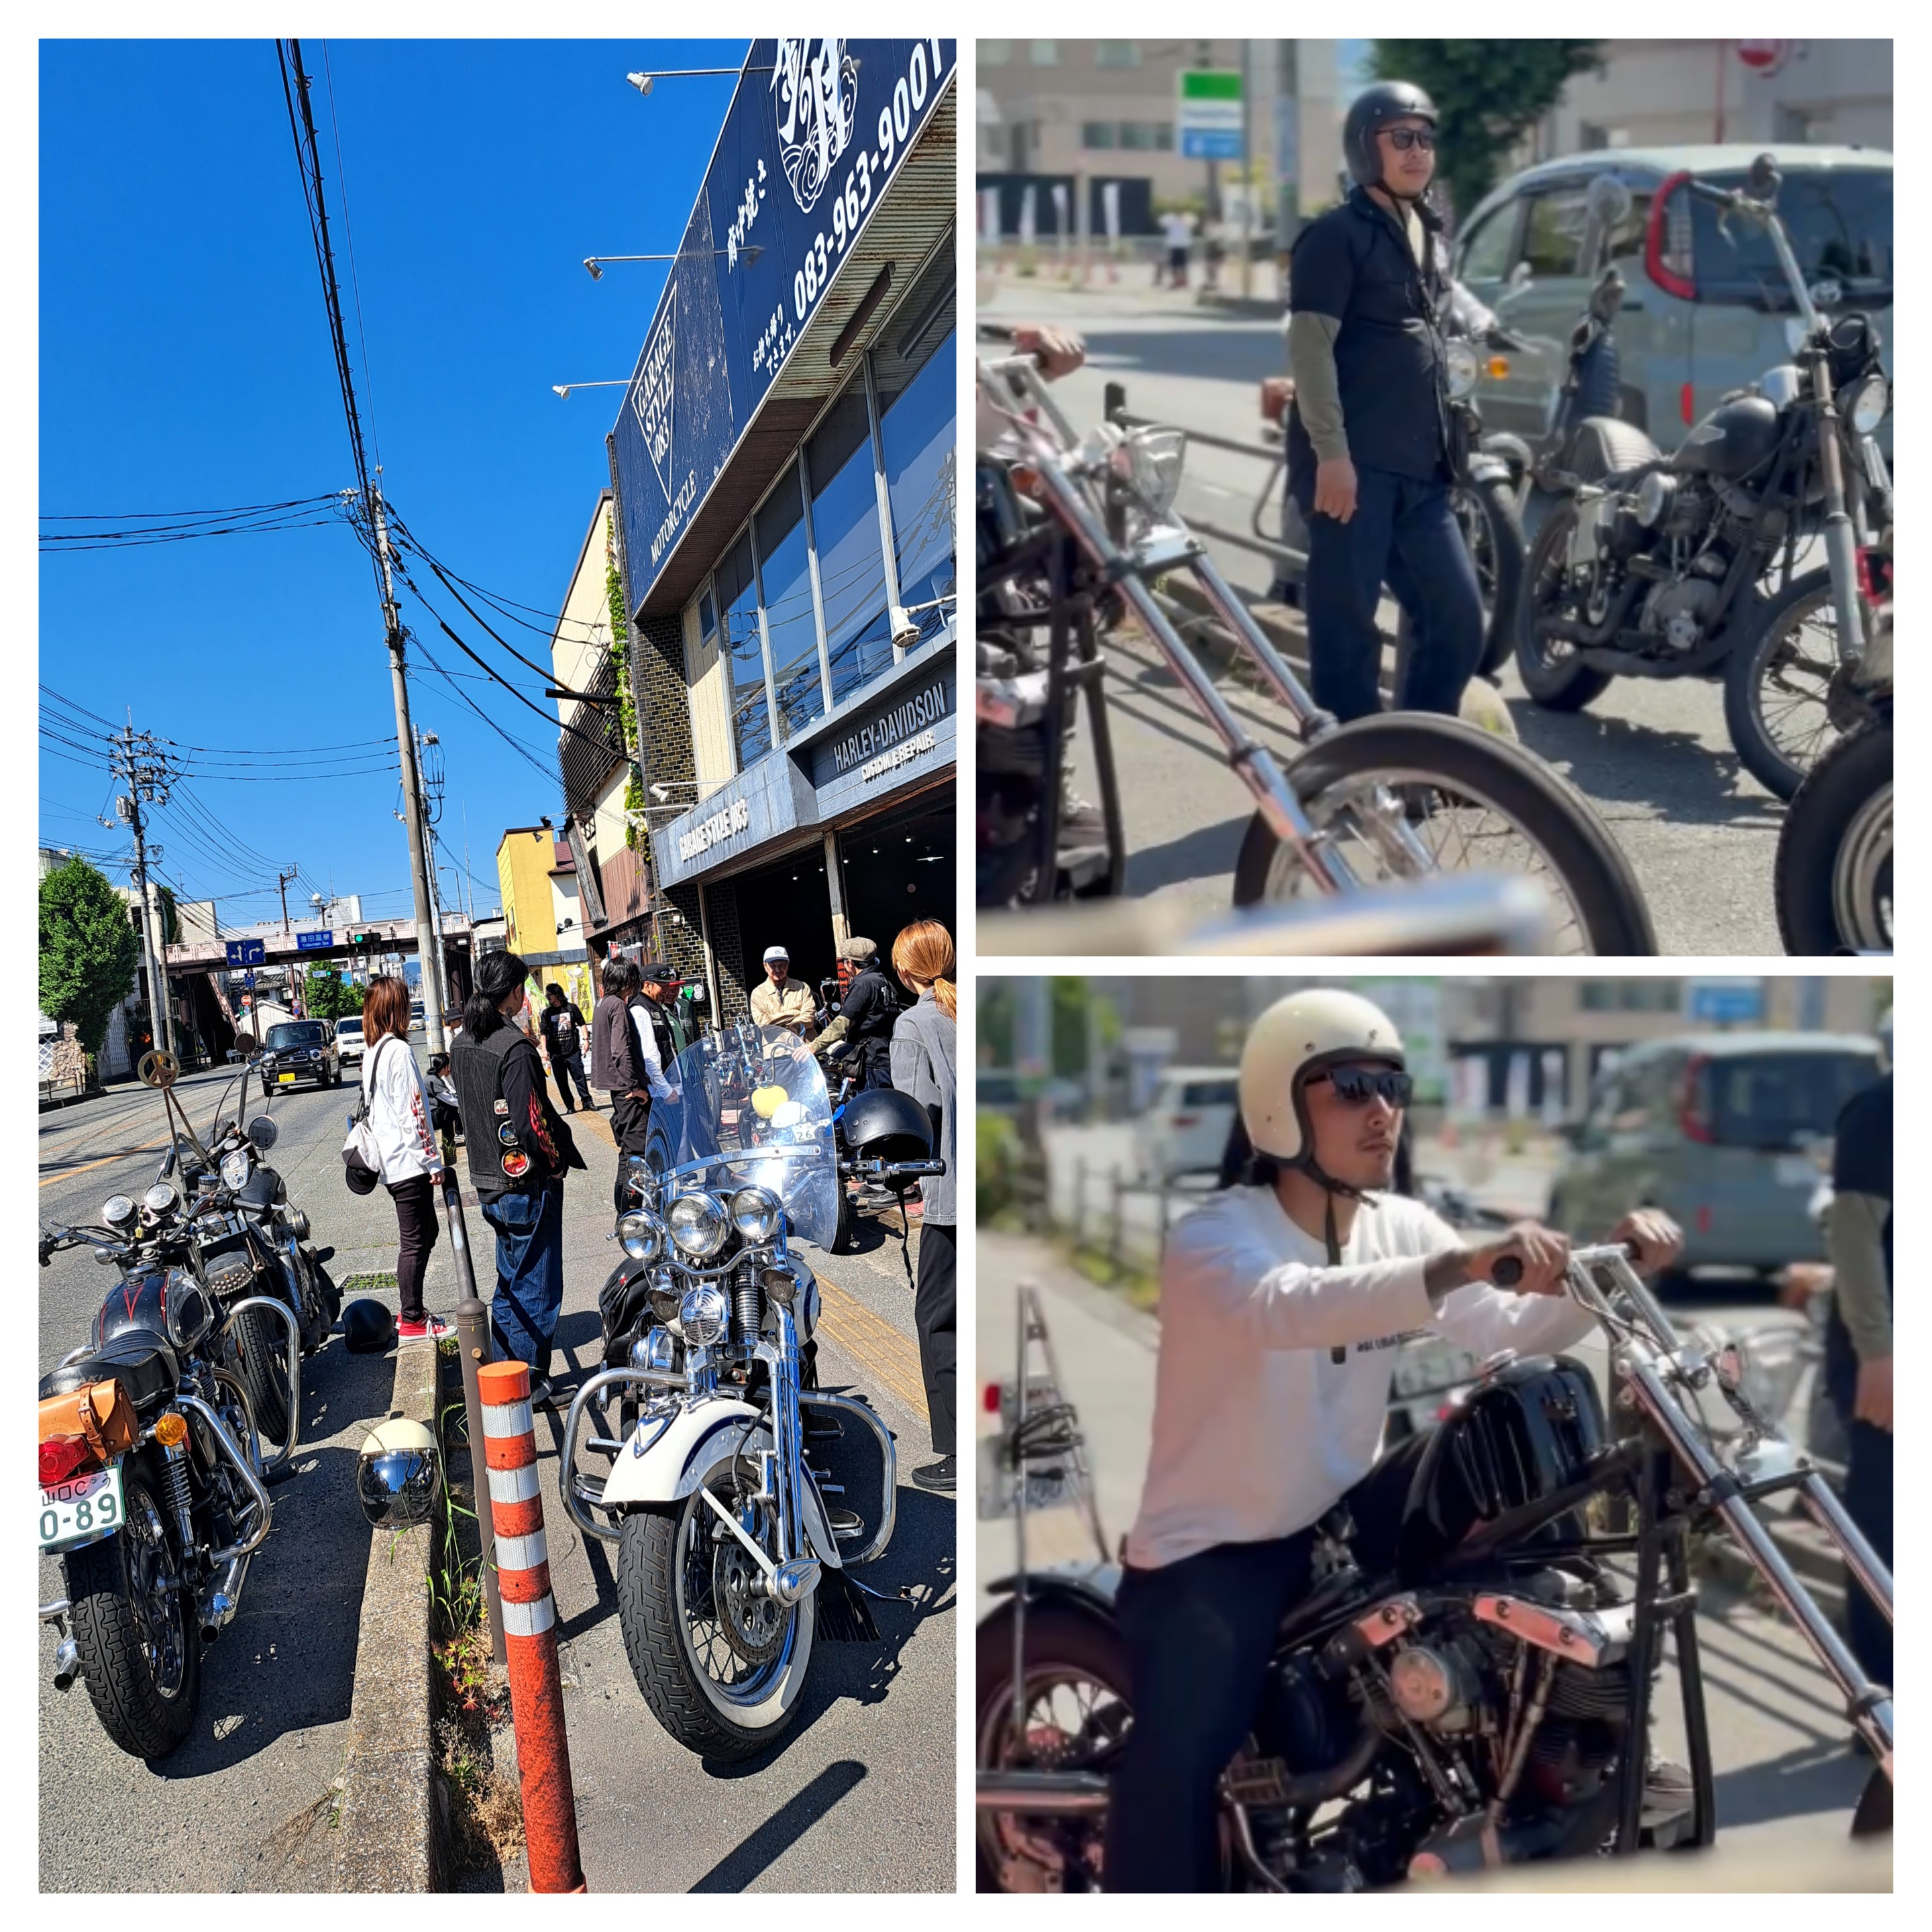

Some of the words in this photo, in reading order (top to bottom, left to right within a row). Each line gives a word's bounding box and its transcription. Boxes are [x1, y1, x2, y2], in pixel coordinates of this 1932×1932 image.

[638, 314, 673, 418] GARAGE
[753, 303, 784, 373] お持ち帰り
[646, 362, 673, 445] STYLE
[654, 415, 669, 465] 083
[651, 469, 696, 568] MOTORCYCLE
[834, 682, 947, 771] HARLEY-DAVIDSON
[861, 753, 893, 780] CUSTOM
[898, 729, 935, 763] REPAIR
[679, 824, 708, 862] GARAGE
[705, 808, 733, 847] STYLE
[730, 798, 749, 833] 083
